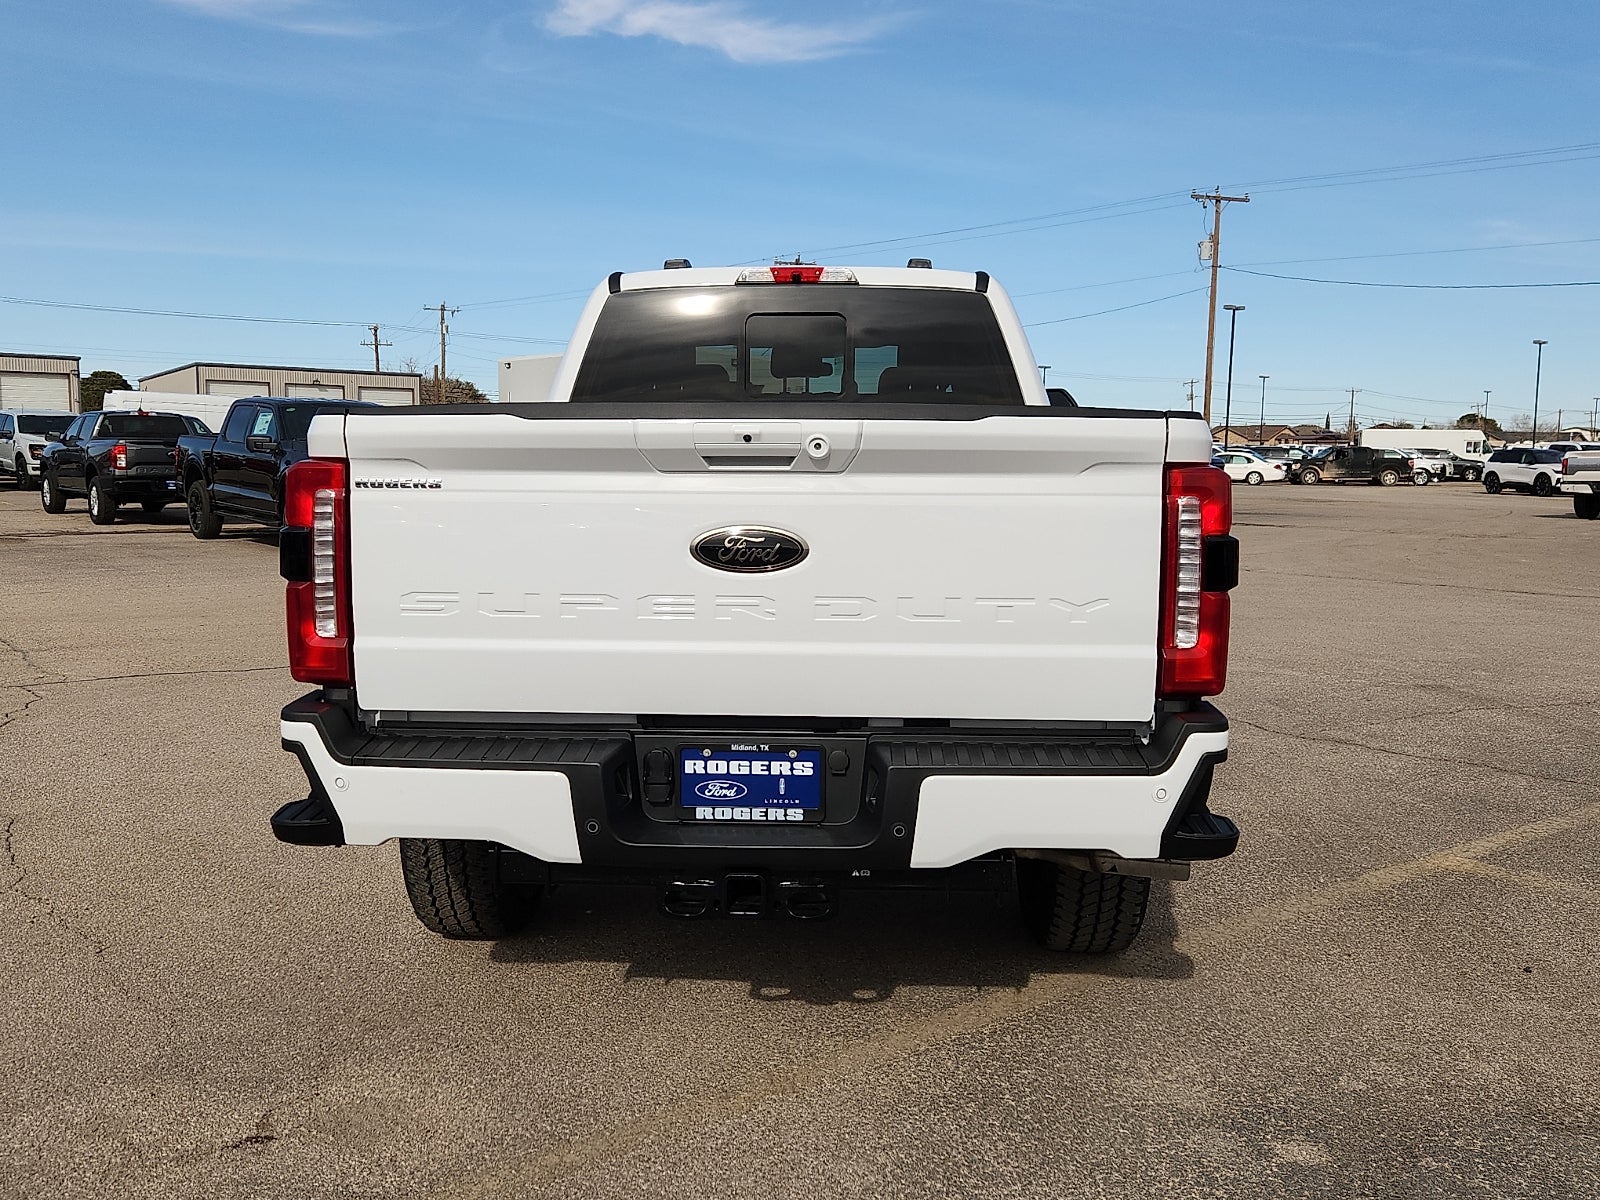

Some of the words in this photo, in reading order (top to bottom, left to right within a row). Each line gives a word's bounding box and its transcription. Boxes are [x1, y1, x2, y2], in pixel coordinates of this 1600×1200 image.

[354, 477, 442, 489] ROGERS
[717, 535, 781, 562] Ford
[399, 591, 776, 621] SUPER
[813, 595, 1110, 624] DUTY
[731, 744, 759, 752] Midland,
[684, 760, 814, 776] ROGERS
[704, 783, 737, 797] Ford
[695, 807, 804, 821] ROGERS
